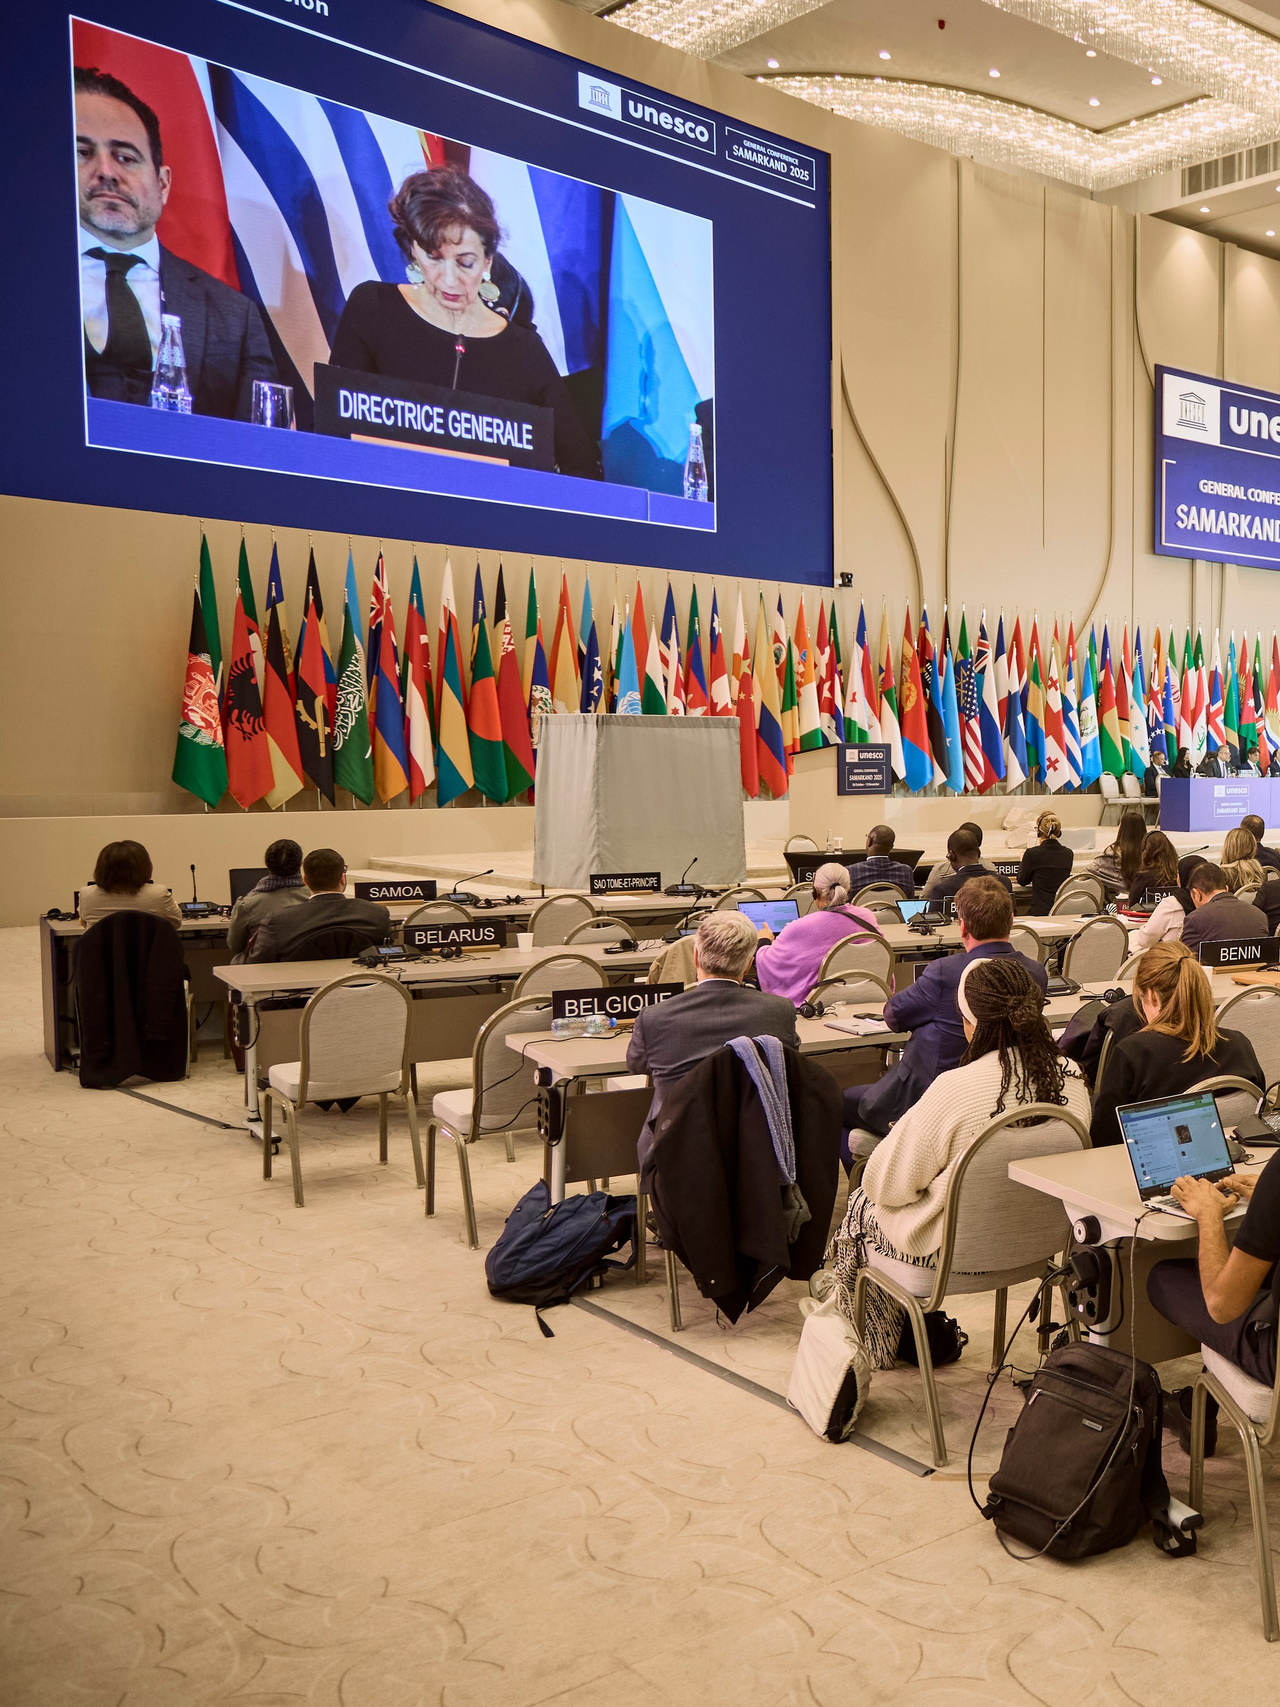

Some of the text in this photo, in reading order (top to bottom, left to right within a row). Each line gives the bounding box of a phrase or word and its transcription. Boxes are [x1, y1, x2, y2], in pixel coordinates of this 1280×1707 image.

[628, 99, 710, 143] unesco
[732, 145, 810, 181] SAMARKAND 2025
[743, 139, 799, 166] GENERAL CONFERENCE
[339, 389, 534, 450] DIRECTRICE GENERALE
[1198, 479, 1248, 500] GENERAL
[369, 886, 424, 898] SAMOA
[593, 877, 658, 889] SAO TOME-ET-PRINCIPE
[414, 927, 495, 945] BELARUS
[1220, 945, 1261, 962] BENIN
